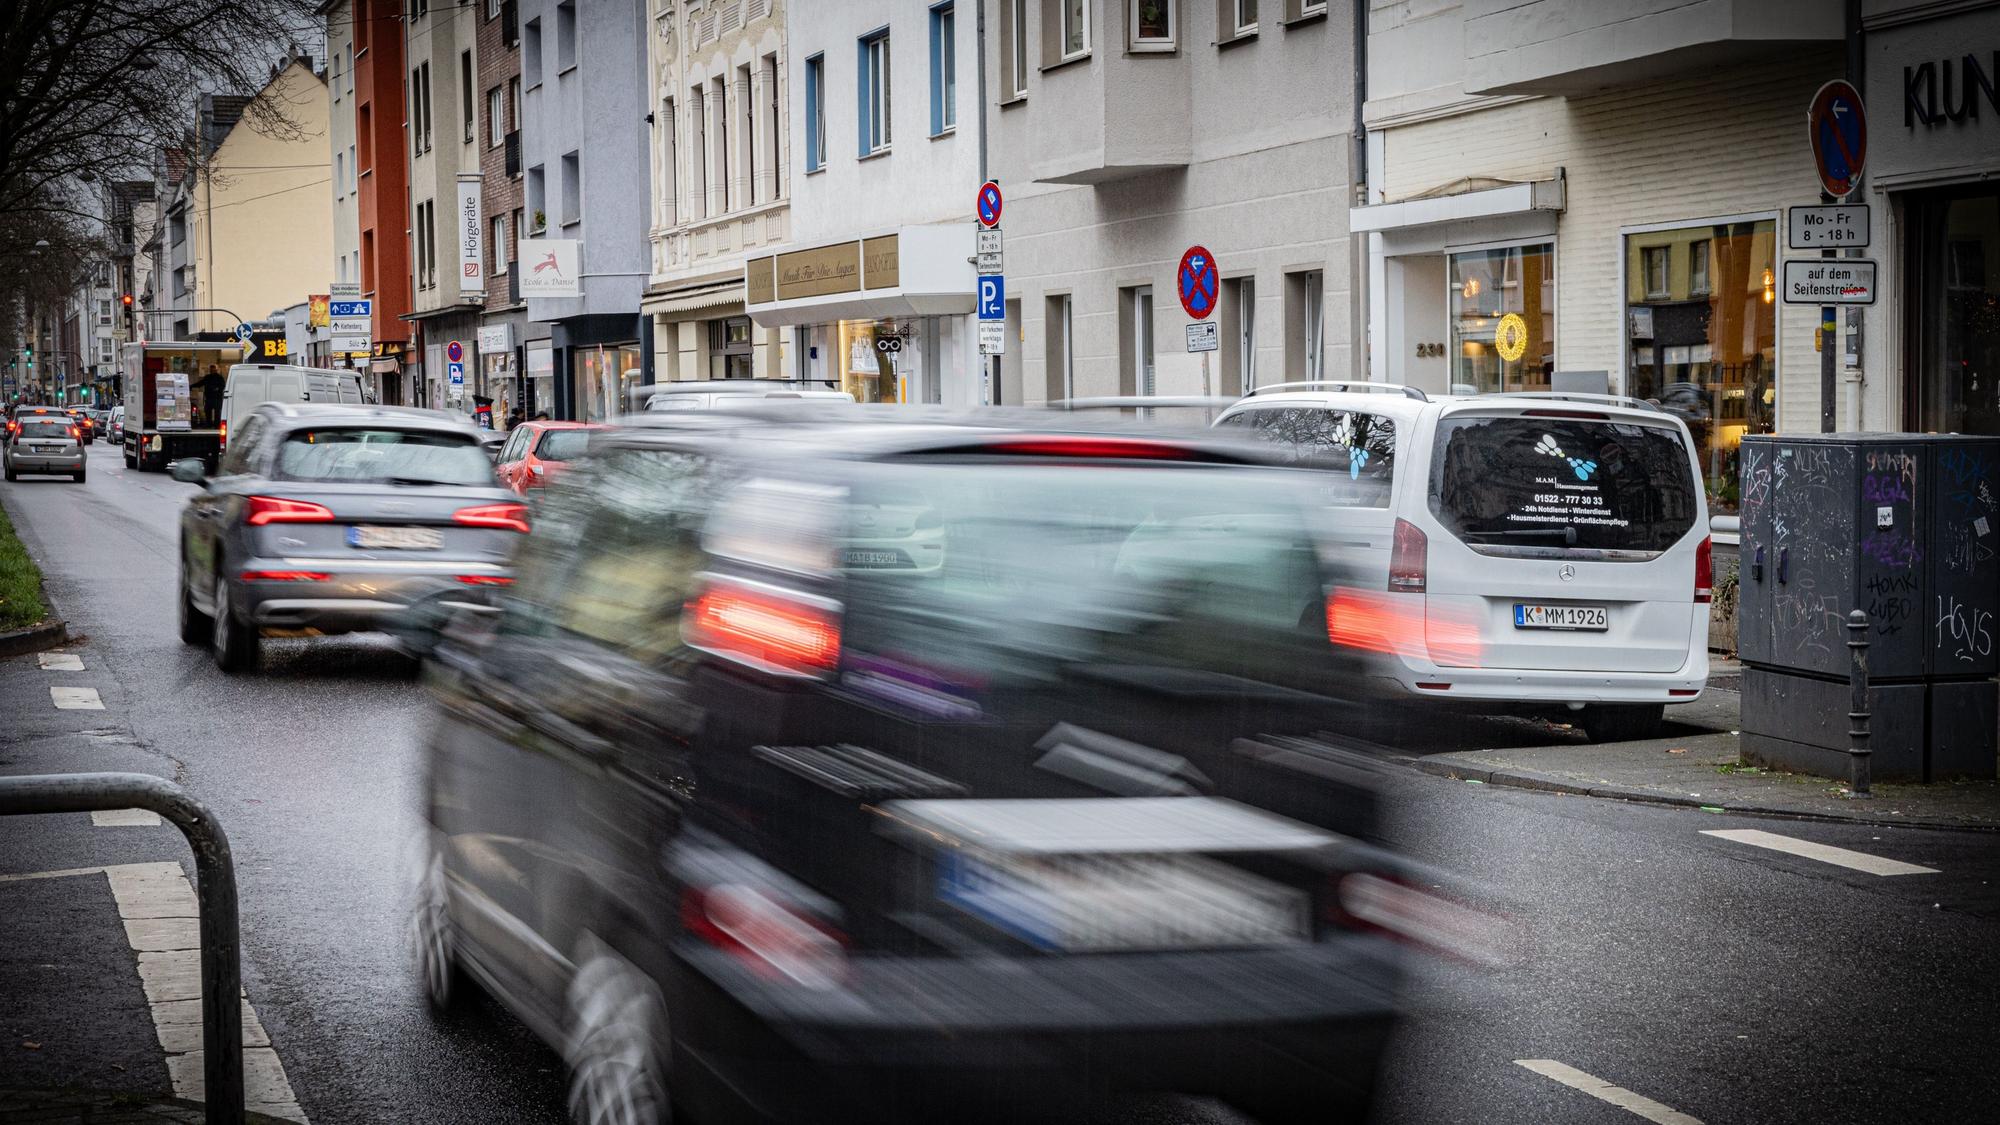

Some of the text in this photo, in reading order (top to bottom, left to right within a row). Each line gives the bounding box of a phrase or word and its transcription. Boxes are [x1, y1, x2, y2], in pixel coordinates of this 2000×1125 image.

[1804, 214, 1824, 225] Mo
[1837, 213, 1851, 224] Fr
[464, 197, 479, 258] Hörgeräte
[1803, 231, 1811, 241] 8
[1828, 229, 1842, 241] 18
[1847, 229, 1855, 239] h
[1808, 267, 1851, 280] auf dem
[1534, 494, 1558, 503] 01522
[1565, 496, 1579, 504] 777
[1581, 496, 1591, 505] 30
[1593, 497, 1603, 505] 33
[1525, 505, 1611, 516] 24h Notdienst Winterdienst
[1510, 514, 1629, 527] Hausmeisterdienst Grünflächenpflege
[1525, 608, 1605, 625] K MM 1926
